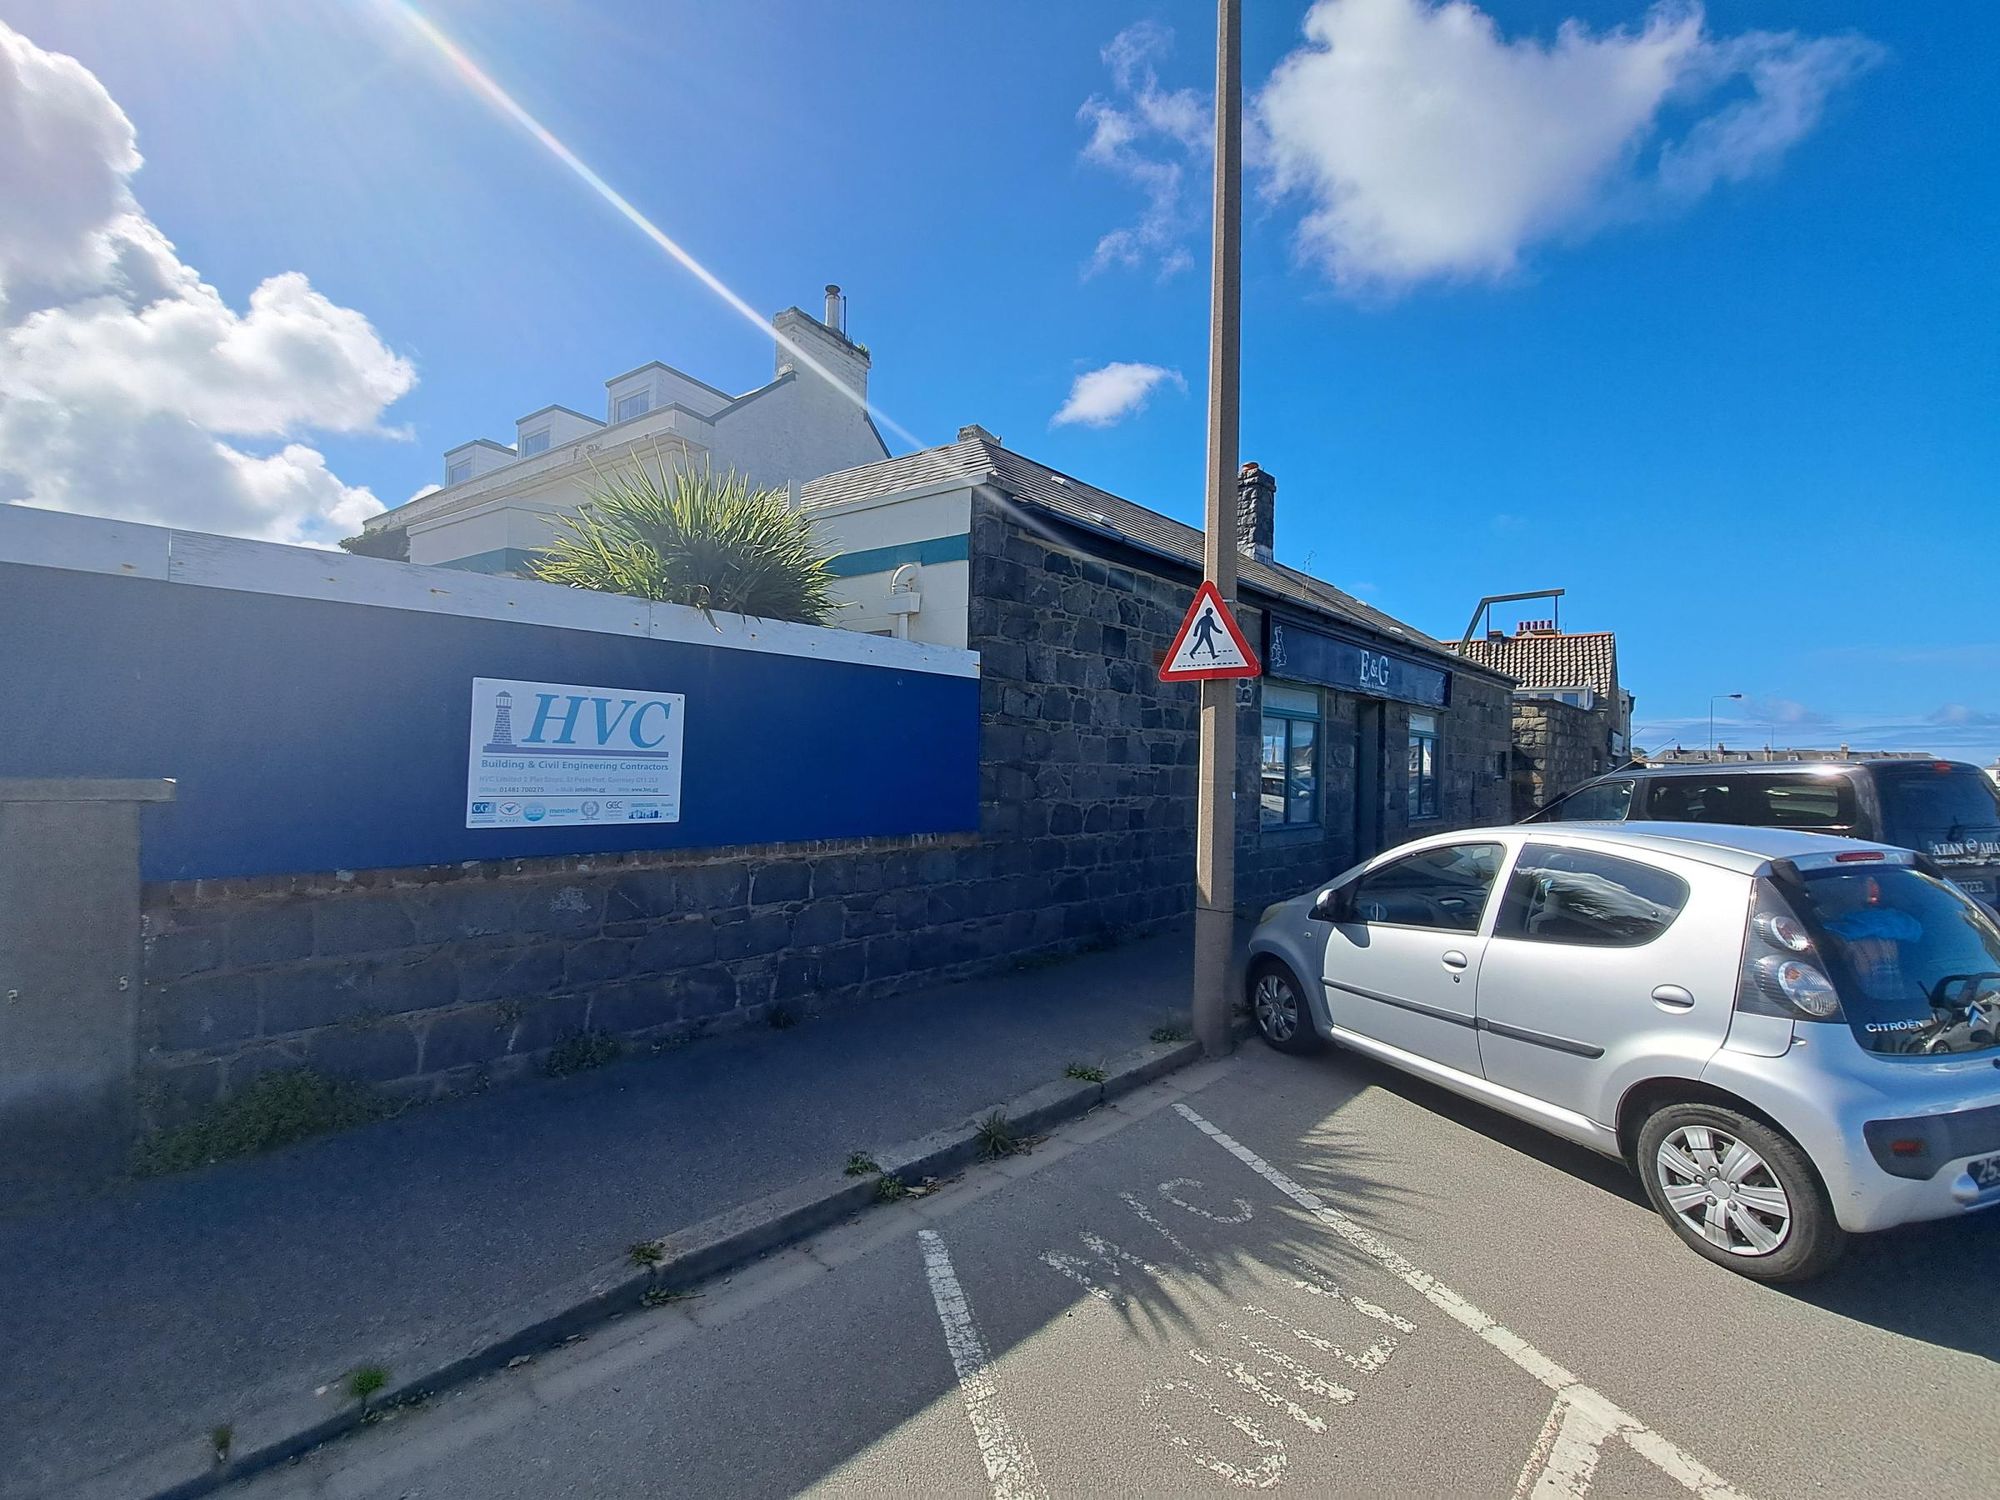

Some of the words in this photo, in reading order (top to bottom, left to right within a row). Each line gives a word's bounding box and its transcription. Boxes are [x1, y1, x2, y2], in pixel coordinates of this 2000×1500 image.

[1360, 649, 1389, 686] E&G
[521, 694, 671, 749] HVC
[481, 760, 525, 770] Building
[528, 760, 535, 769] &
[538, 760, 559, 769] Civil
[562, 761, 618, 772] Engineering
[620, 762, 669, 771] Contractors
[1865, 1018, 1924, 1033] CITROËN
[1977, 1156, 2000, 1184] 25
[1140, 1257, 1418, 1489] ONLY
